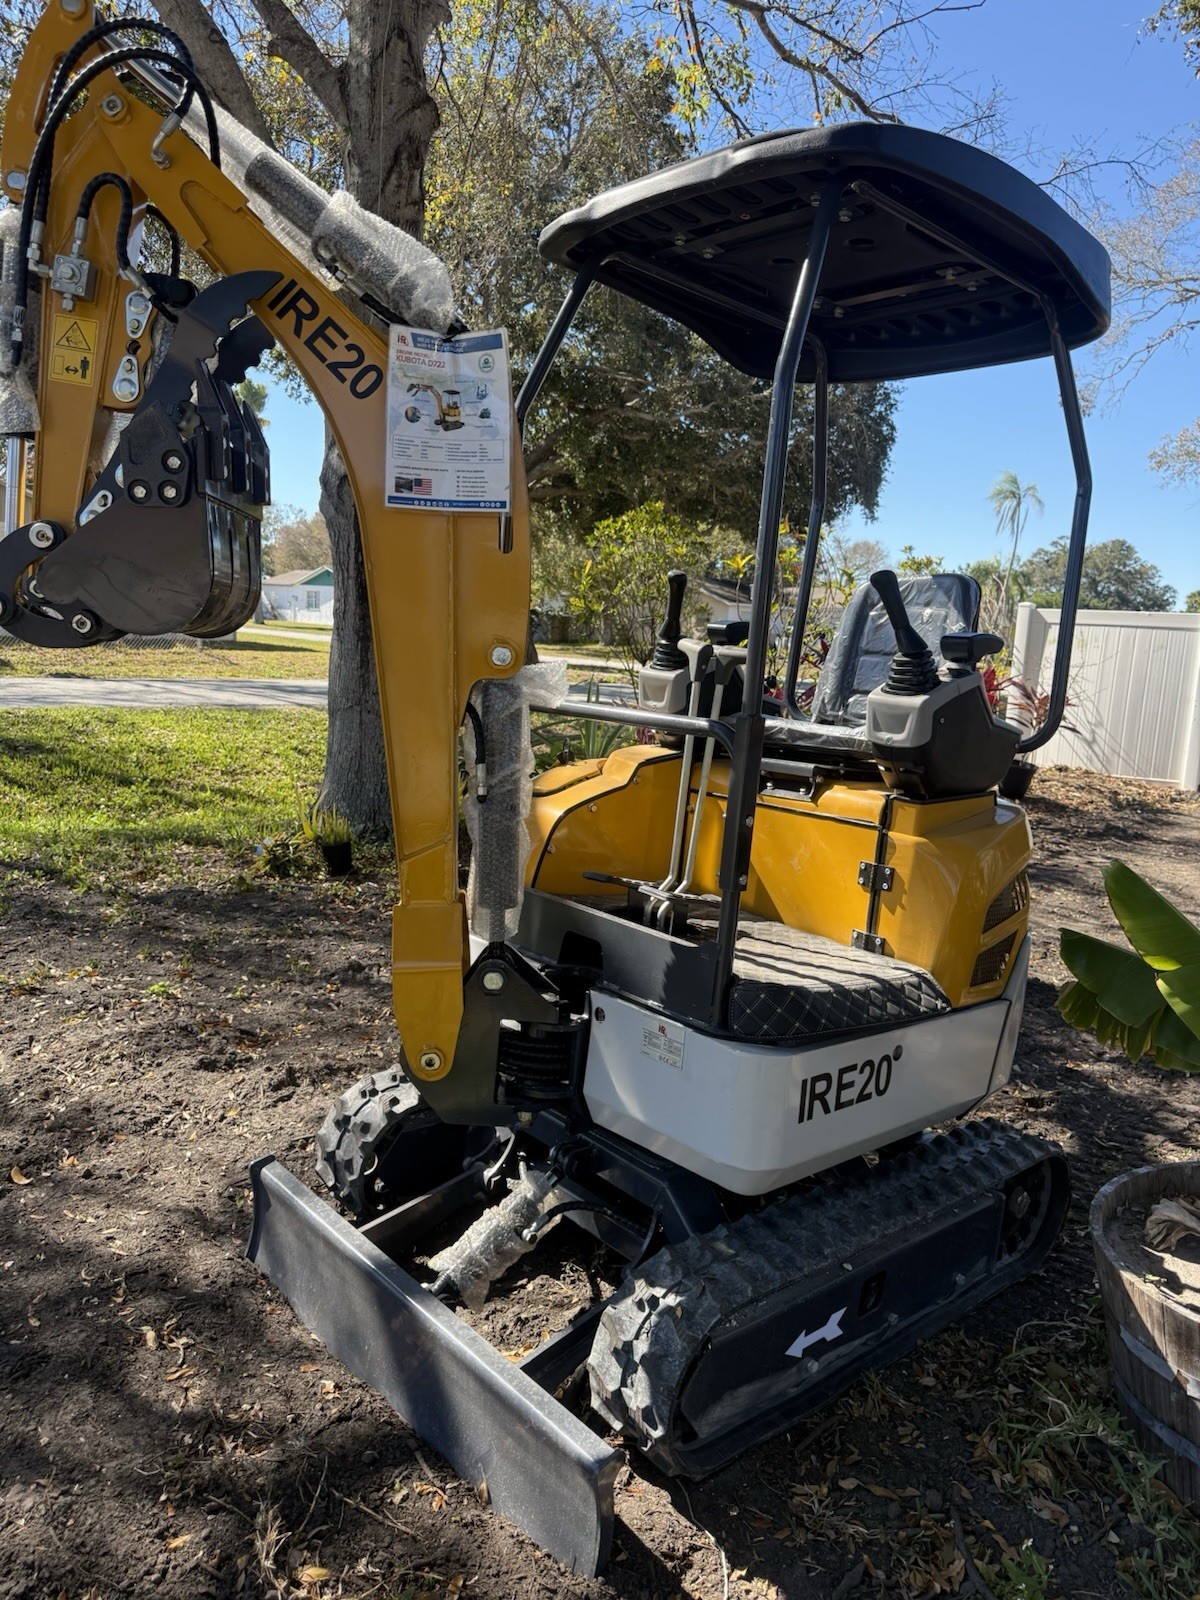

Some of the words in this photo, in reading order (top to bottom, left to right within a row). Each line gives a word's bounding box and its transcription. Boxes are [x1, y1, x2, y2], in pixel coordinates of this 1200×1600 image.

[266, 278, 384, 400] IRE20
[396, 355, 426, 366] KUBOTA
[428, 360, 446, 368] D722
[798, 1054, 893, 1125] IRE20
